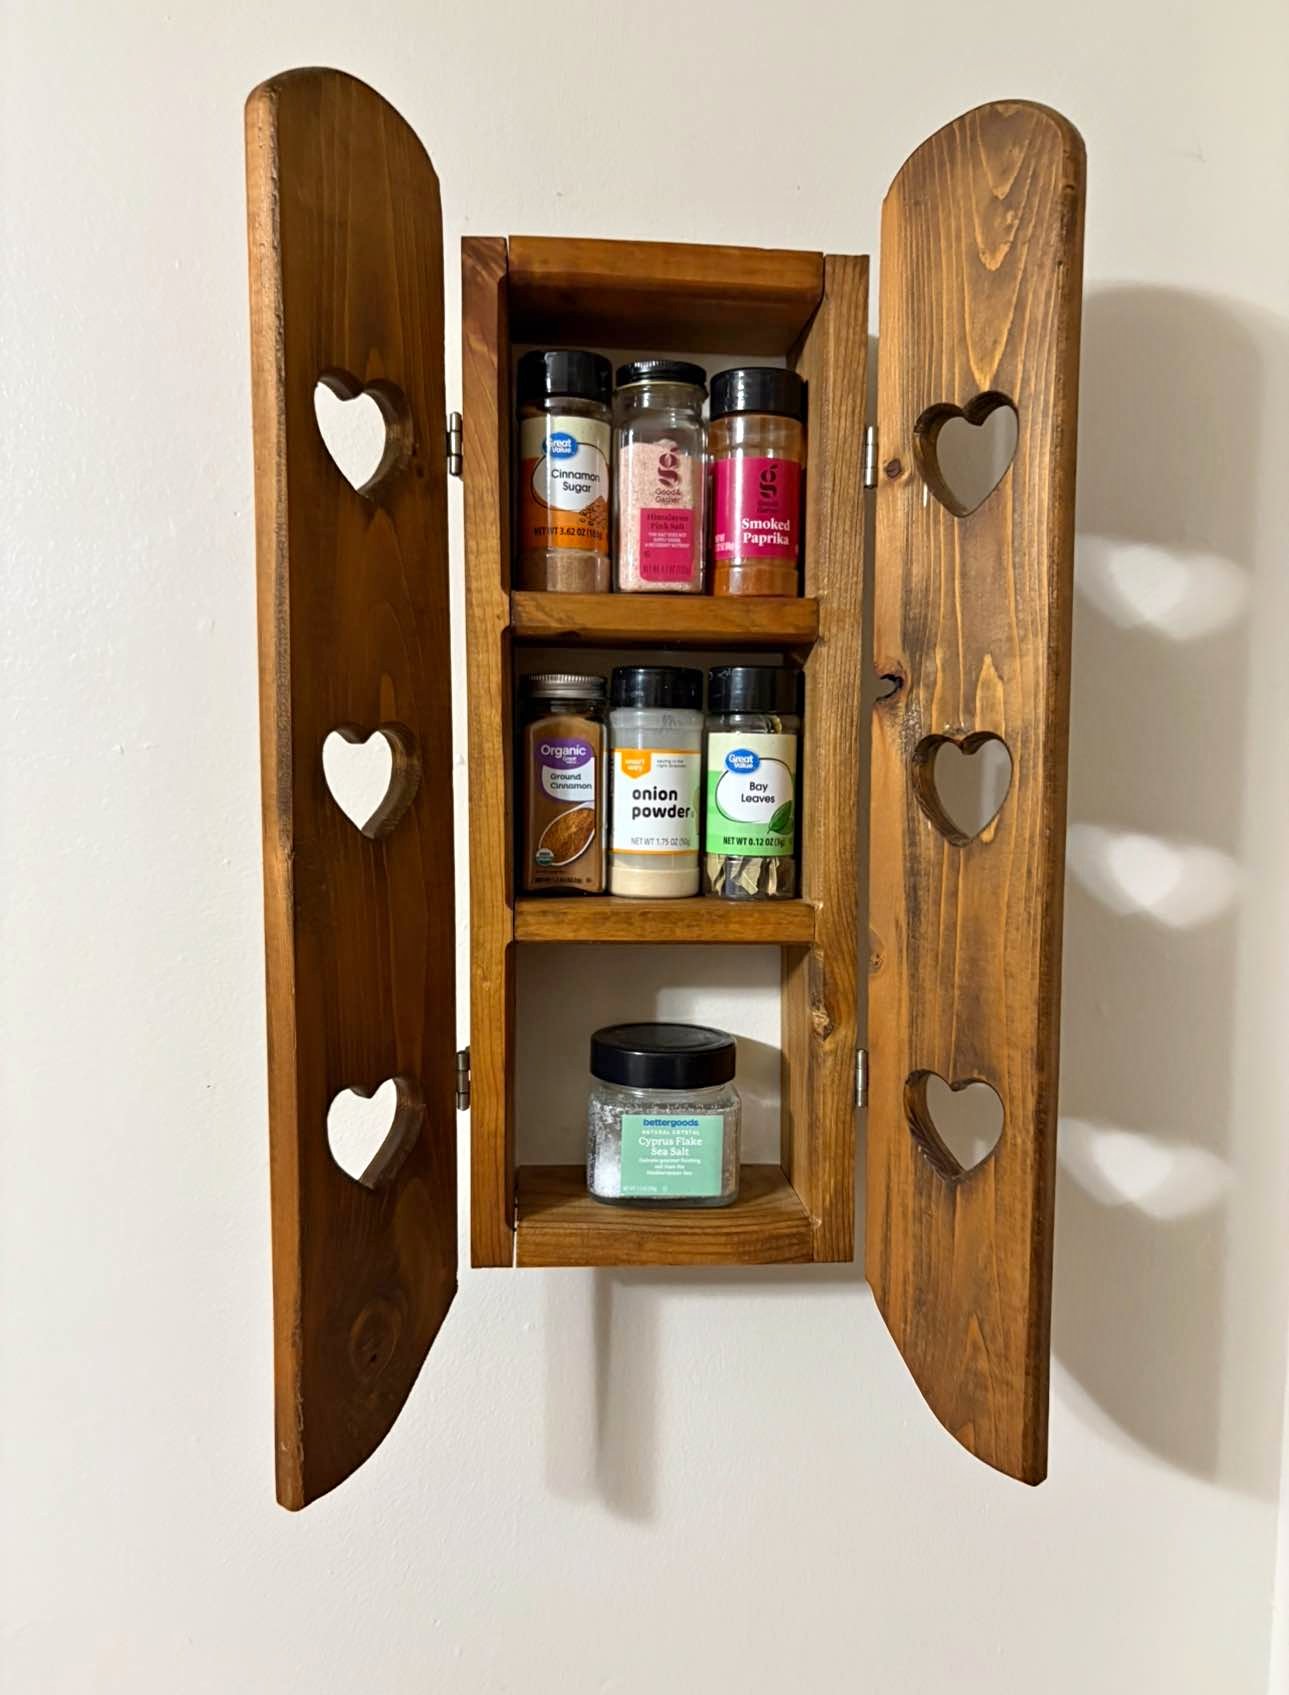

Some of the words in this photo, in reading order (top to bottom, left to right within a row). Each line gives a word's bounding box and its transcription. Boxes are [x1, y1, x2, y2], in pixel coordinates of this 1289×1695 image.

[551, 469, 600, 482] Cinnamon
[562, 481, 592, 493] Sugar
[741, 518, 791, 531] Smoked
[559, 528, 576, 536] 3.62
[577, 528, 586, 536] OZ
[743, 532, 790, 547] Paprika
[540, 744, 587, 759] Organic
[728, 754, 754, 764] Great
[550, 773, 582, 781] Ground
[550, 782, 593, 791] Cinnamon
[749, 782, 768, 793] Bay
[632, 786, 677, 801] onion
[741, 793, 776, 804] Leaves
[632, 804, 690, 820] powder
[631, 837, 642, 846] NET
[644, 837, 655, 846] WT
[656, 838, 669, 846] 1.75
[670, 838, 678, 846] OZ
[723, 836, 735, 845] NET
[736, 837, 747, 846] WT
[748, 837, 764, 846] 0.12
[765, 838, 774, 847] OZ
[643, 1119, 699, 1128] bettergoods
[638, 1137, 674, 1148] Cyprus
[676, 1136, 703, 1146] Flake
[651, 1147, 668, 1156] Sea
[670, 1147, 689, 1156] Salt
